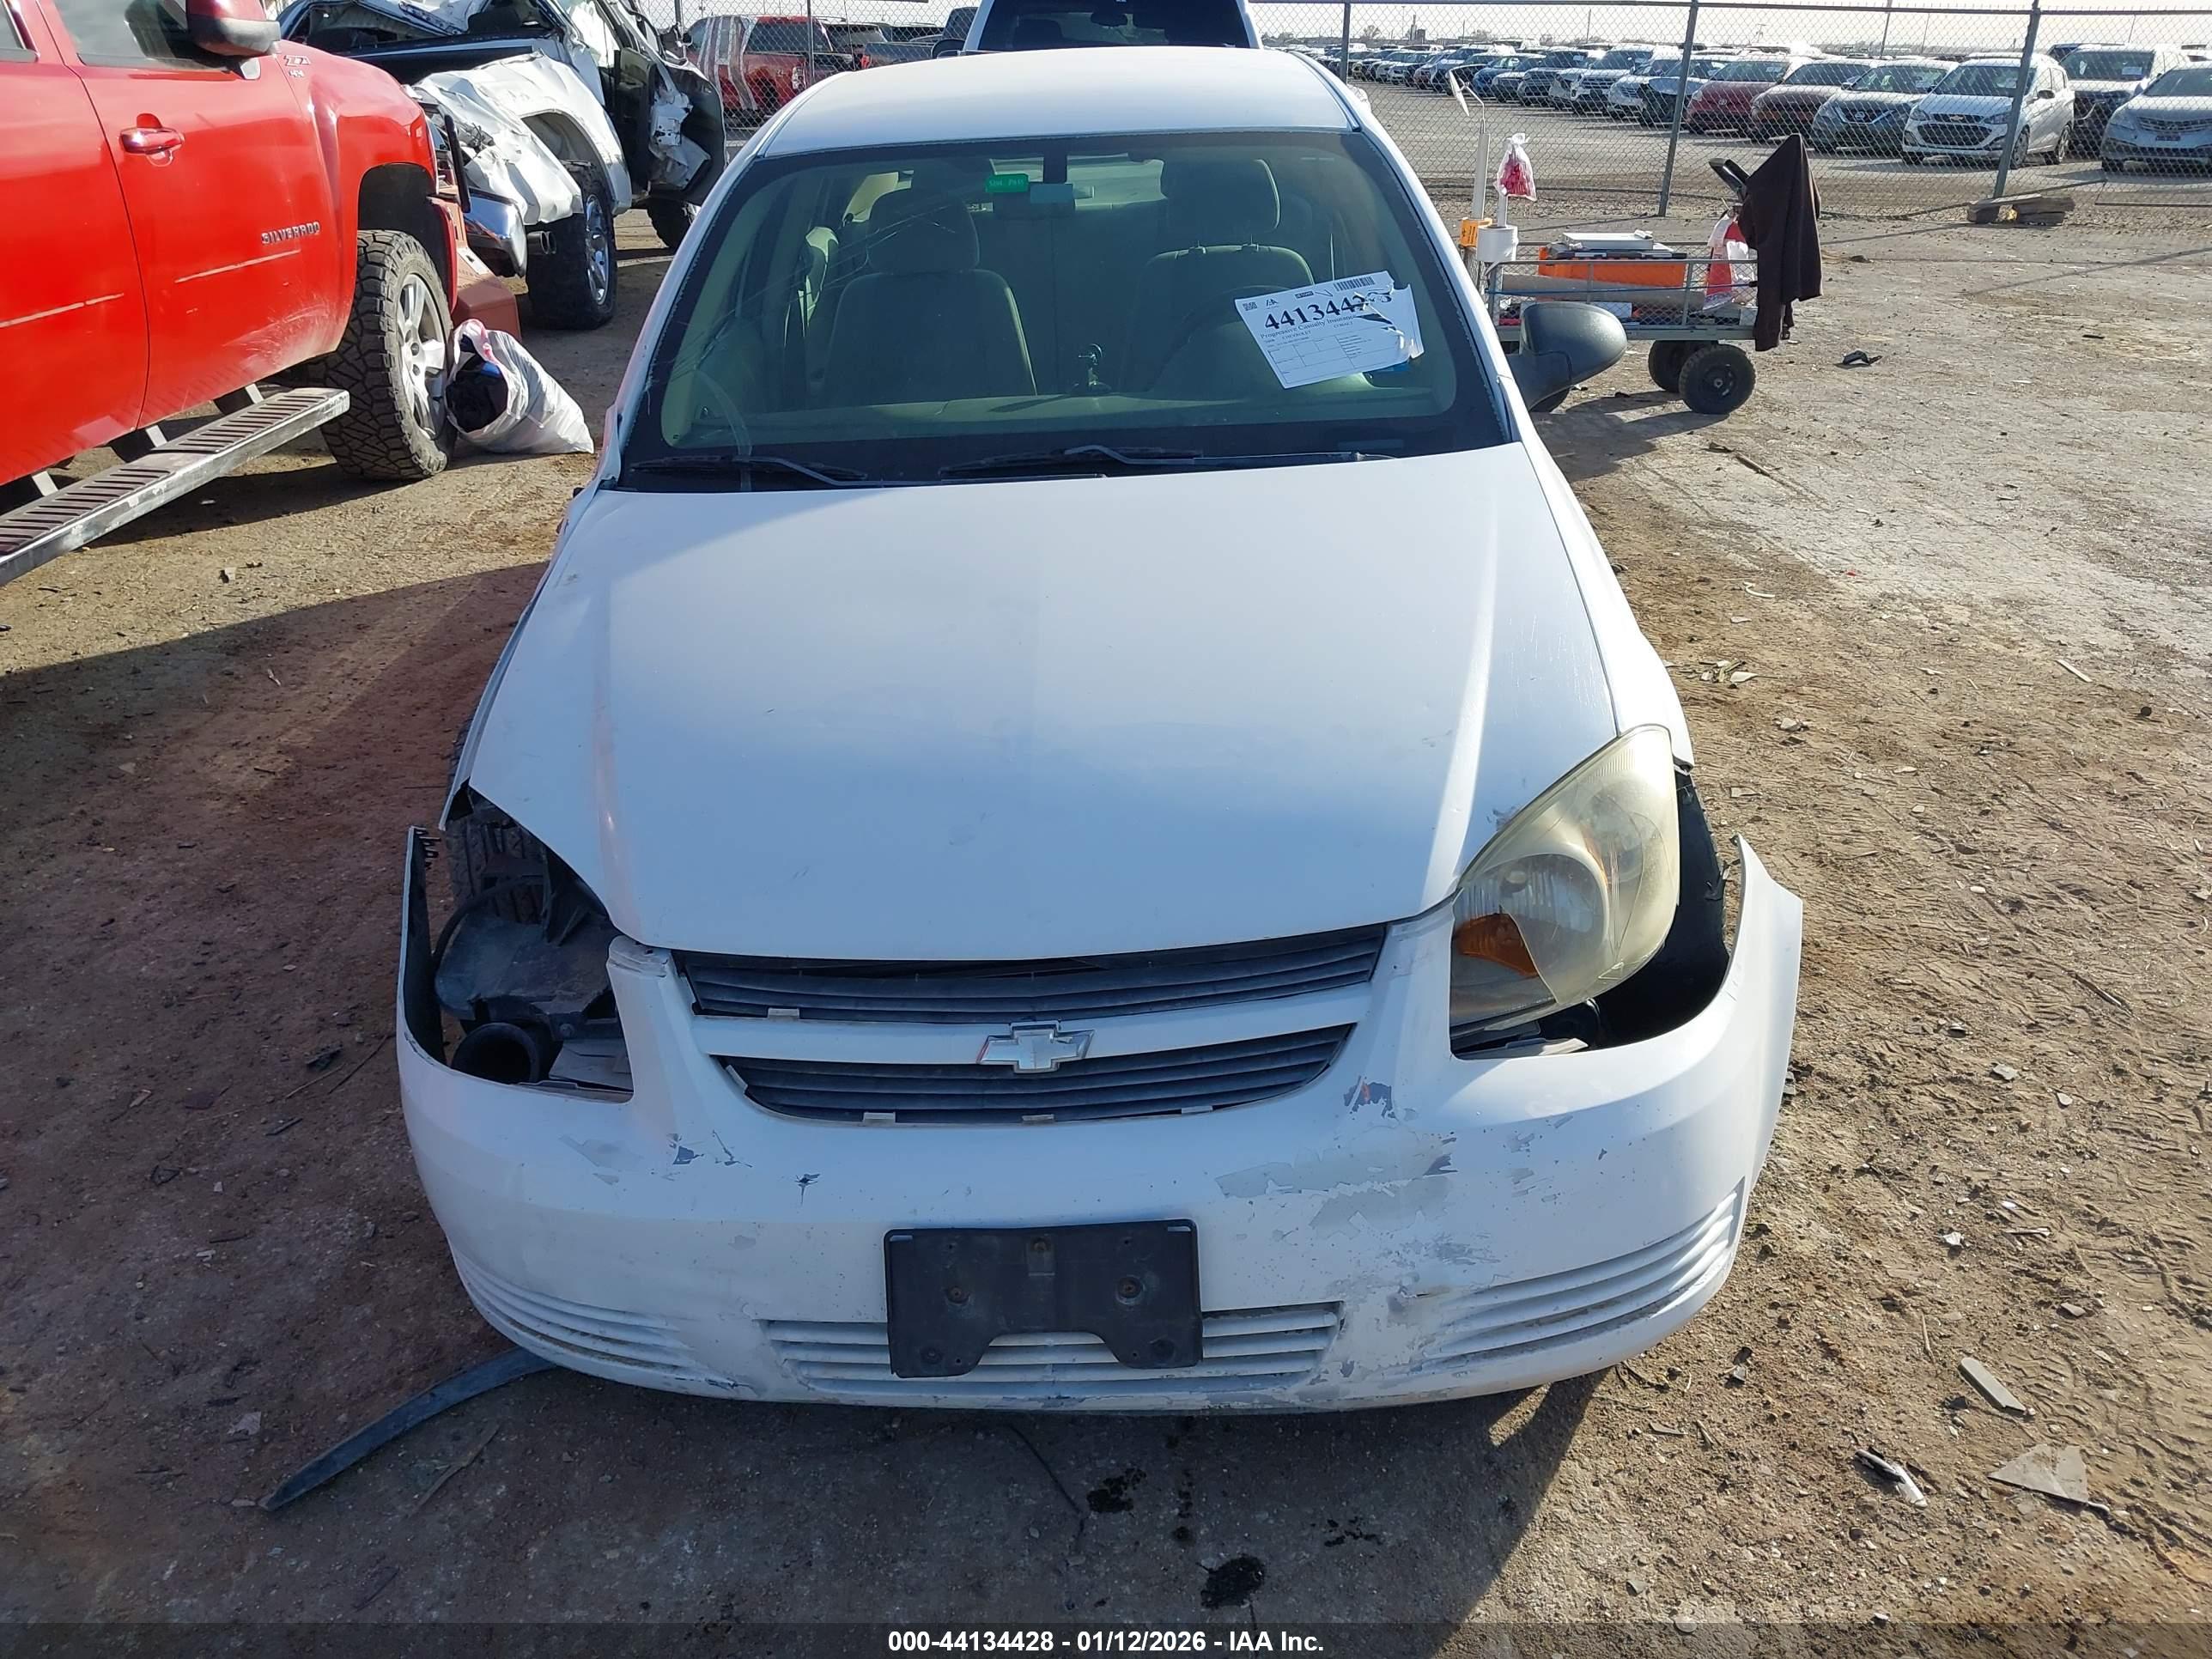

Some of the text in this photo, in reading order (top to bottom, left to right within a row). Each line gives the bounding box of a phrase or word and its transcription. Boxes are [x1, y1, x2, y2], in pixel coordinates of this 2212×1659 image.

[283, 55, 311, 66] Z71
[261, 221, 321, 244] SILVERADO
[1260, 327, 1297, 339] Progressive
[1298, 320, 1326, 332] Casualty
